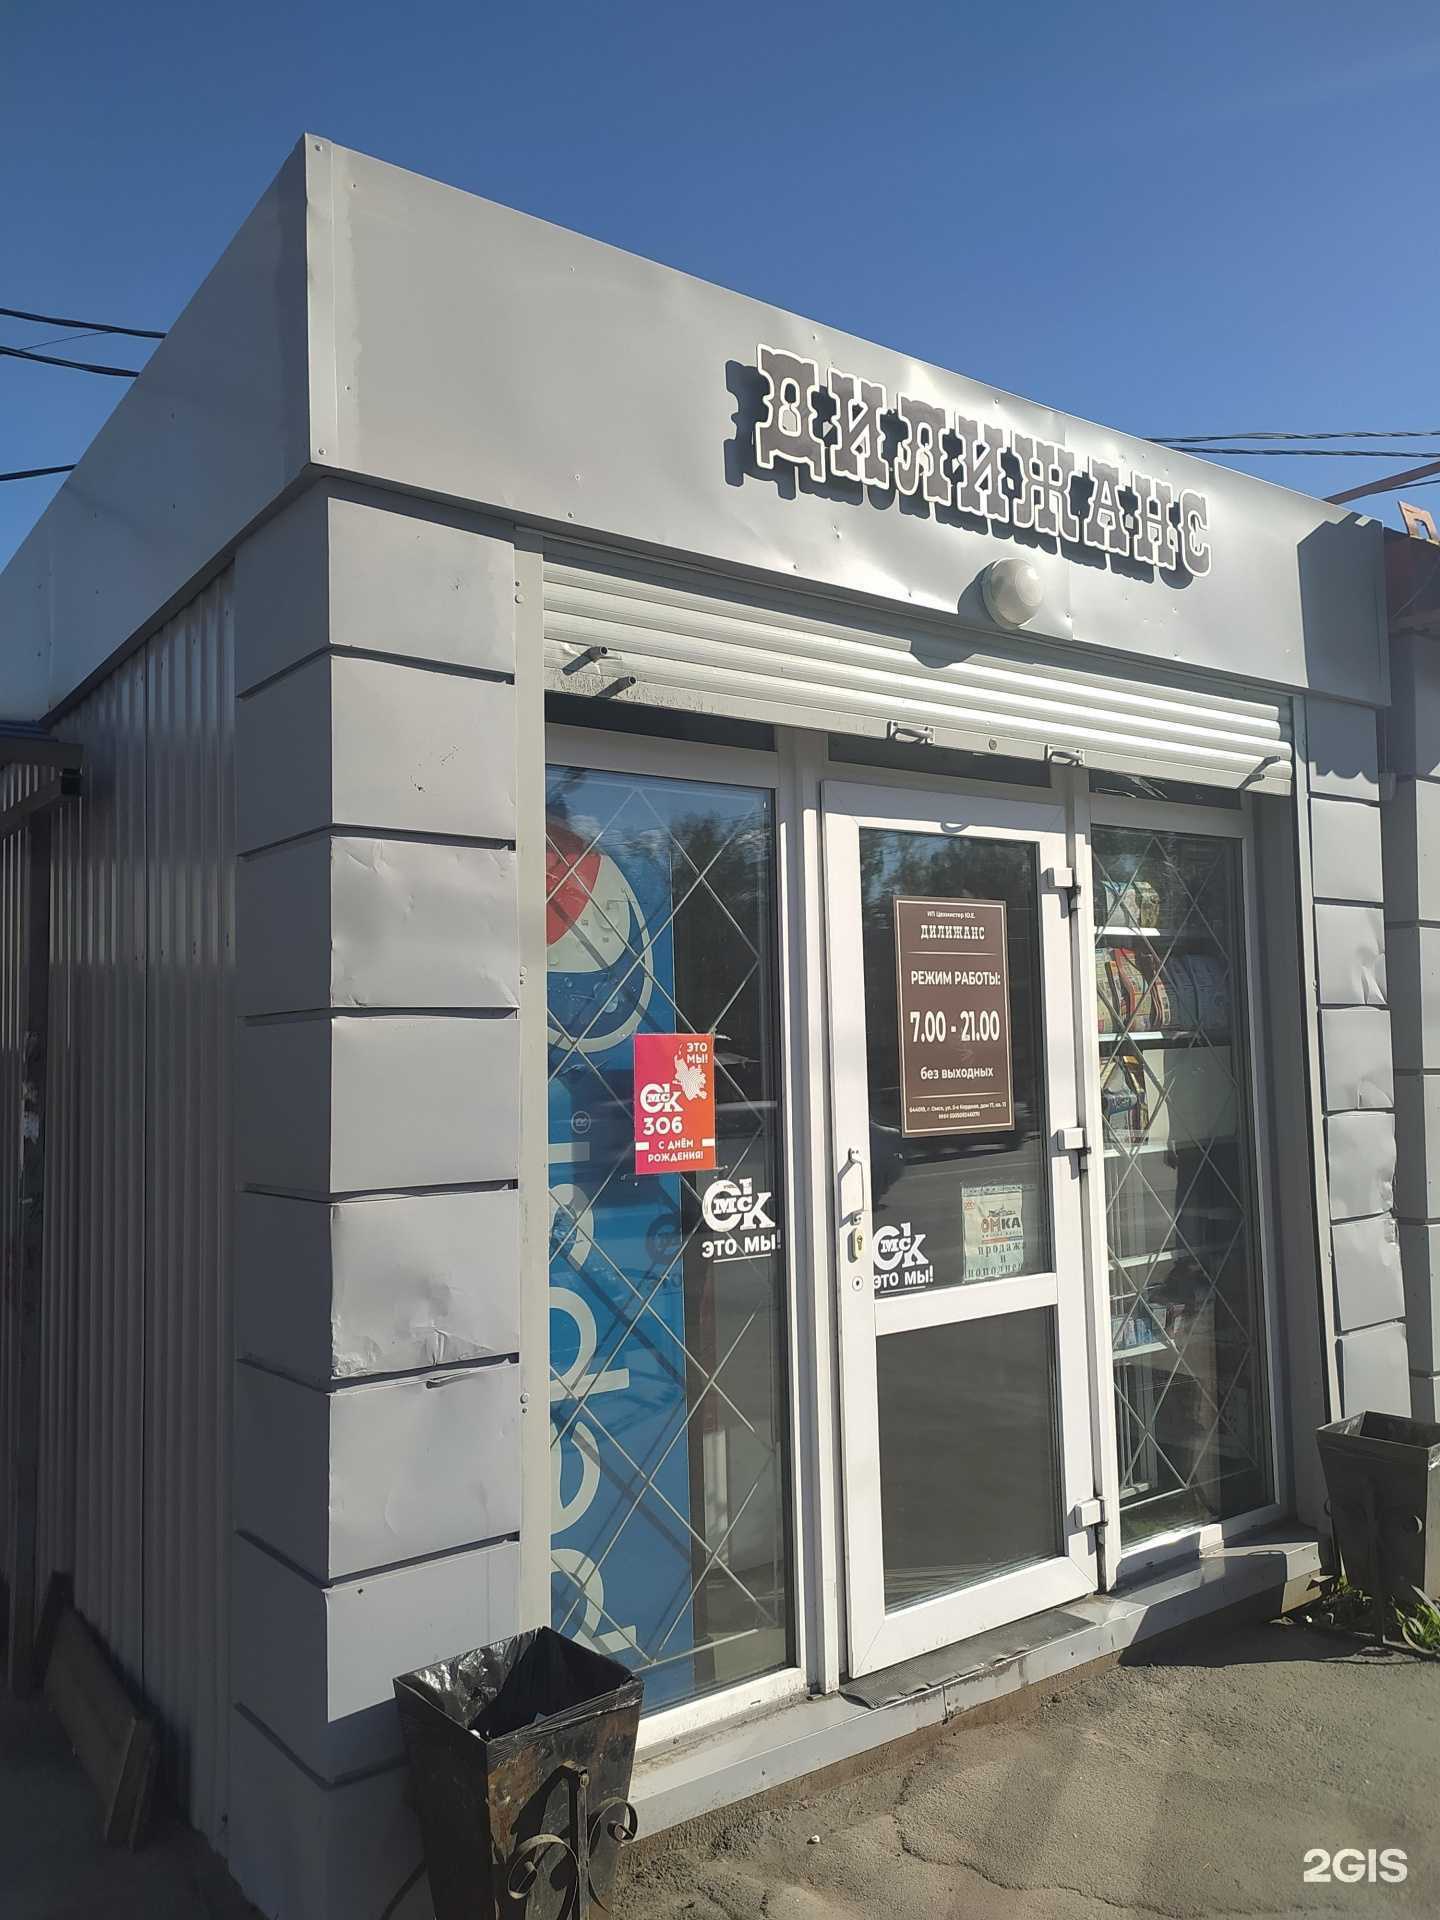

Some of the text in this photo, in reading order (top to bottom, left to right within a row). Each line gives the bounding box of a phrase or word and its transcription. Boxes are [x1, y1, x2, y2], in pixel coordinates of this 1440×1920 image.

[757, 344, 1211, 577] ДИЛИЖАНС
[920, 924, 985, 940] ДИЛИЖАНС
[911, 970, 1001, 986] РЕЖИМ РАБОТЫ:
[910, 1010, 947, 1043] 7.00
[960, 1010, 1000, 1042] 21.00
[686, 1042, 708, 1052] ЭТО
[686, 1054, 708, 1064] МЫ!
[920, 1066, 994, 1080] без выходных
[642, 1116, 683, 1136] 306
[658, 1137, 694, 1150] С ДНЁМ
[647, 1150, 704, 1163] РОЖДЕНИЯ!
